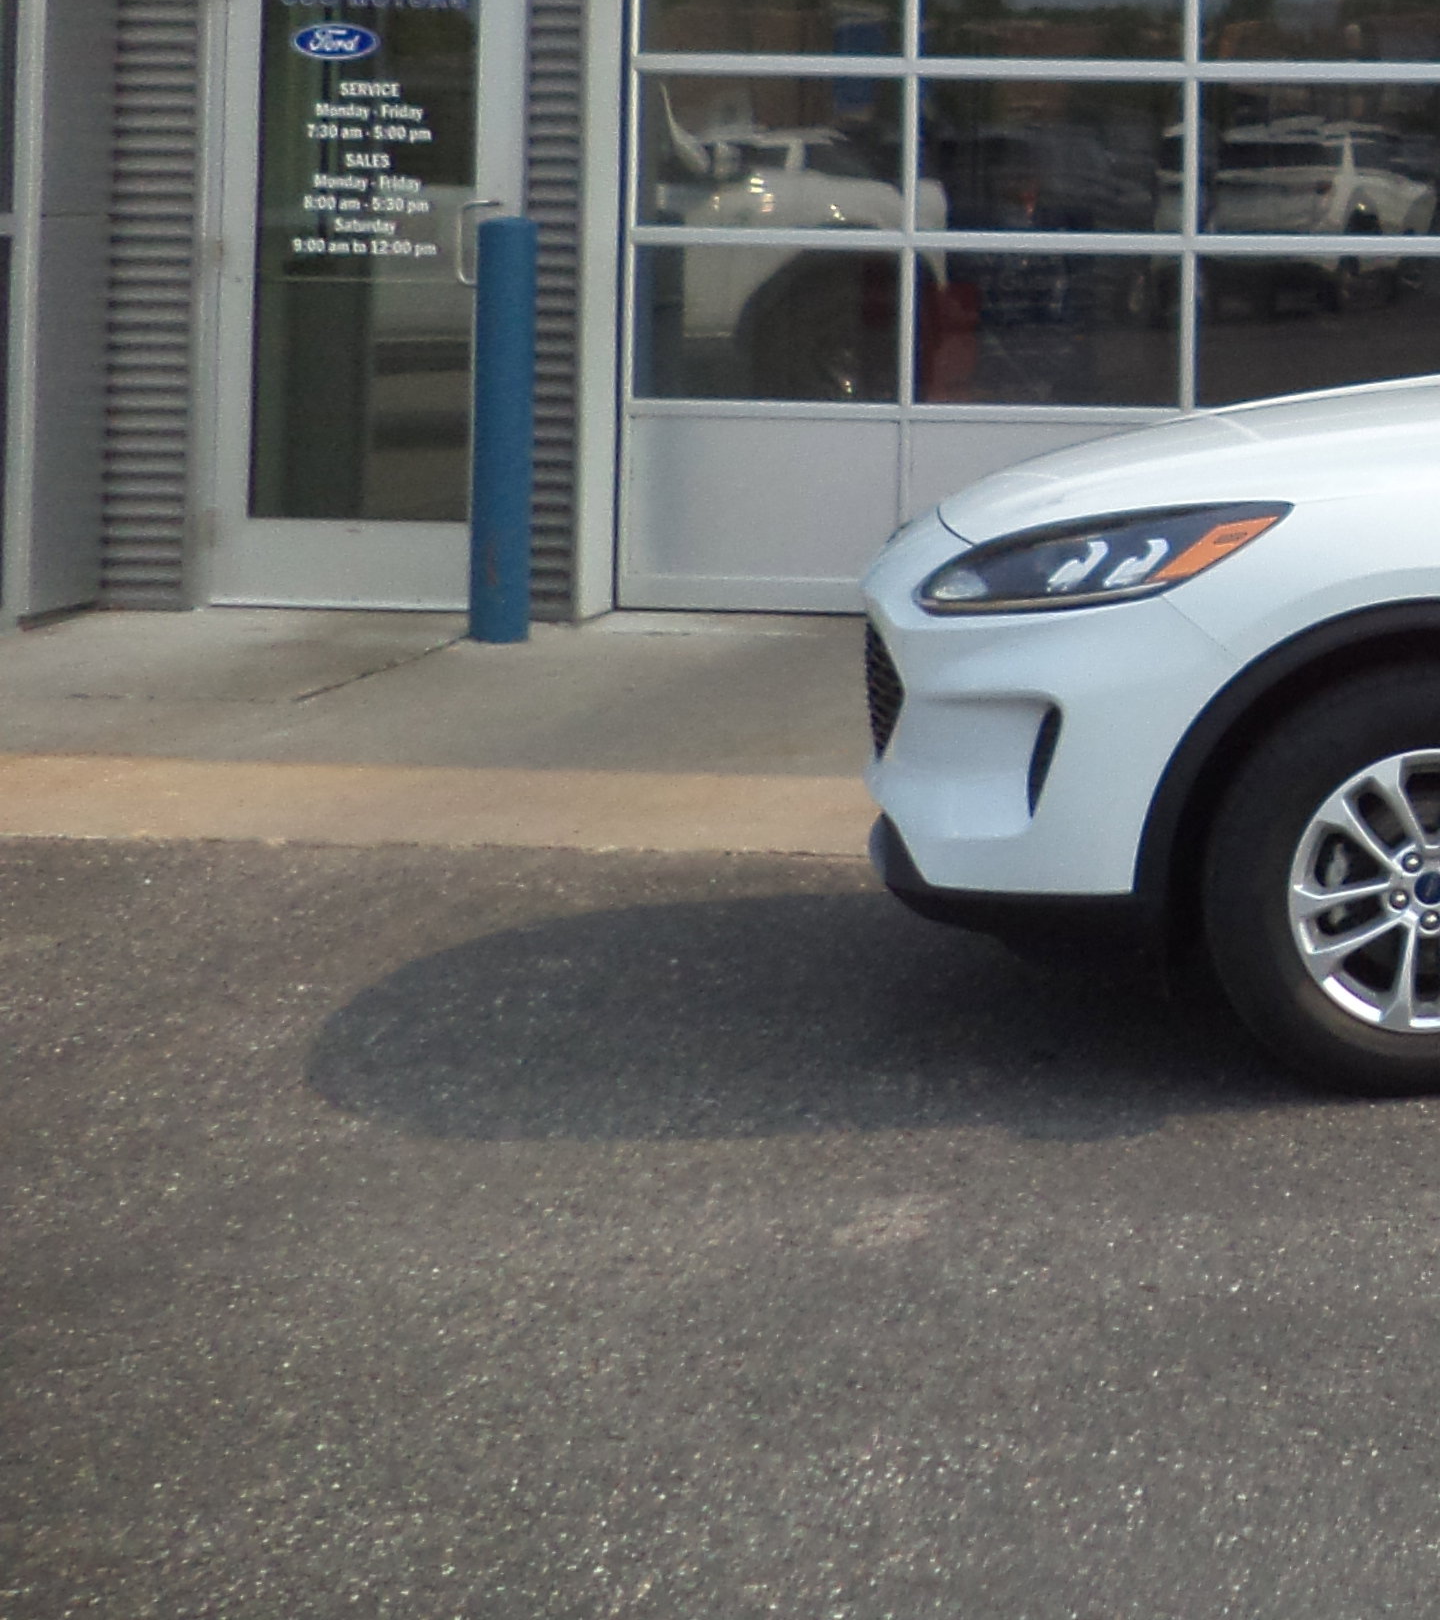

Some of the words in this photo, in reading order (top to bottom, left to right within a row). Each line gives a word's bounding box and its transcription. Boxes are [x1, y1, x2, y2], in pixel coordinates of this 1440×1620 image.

[309, 28, 360, 52] Ford
[339, 82, 400, 97] SERVICE
[315, 102, 370, 121] Monday
[380, 104, 424, 122] Friday
[306, 123, 338, 139] 7:30
[340, 127, 363, 139] am
[372, 124, 406, 140] 5:00
[409, 128, 432, 144] pm
[345, 153, 391, 168] SALES
[313, 173, 368, 192] Monday
[379, 175, 422, 193] Friday
[303, 194, 336, 210] 8:00
[338, 198, 361, 210] am
[372, 196, 404, 212] 5:30
[407, 200, 430, 214] pm
[334, 217, 396, 235] Saturday
[292, 238, 325, 253] 9:00
[328, 241, 350, 253] am
[352, 239, 367, 253] to
[371, 240, 412, 255] 12:00
[414, 243, 437, 258] pm
